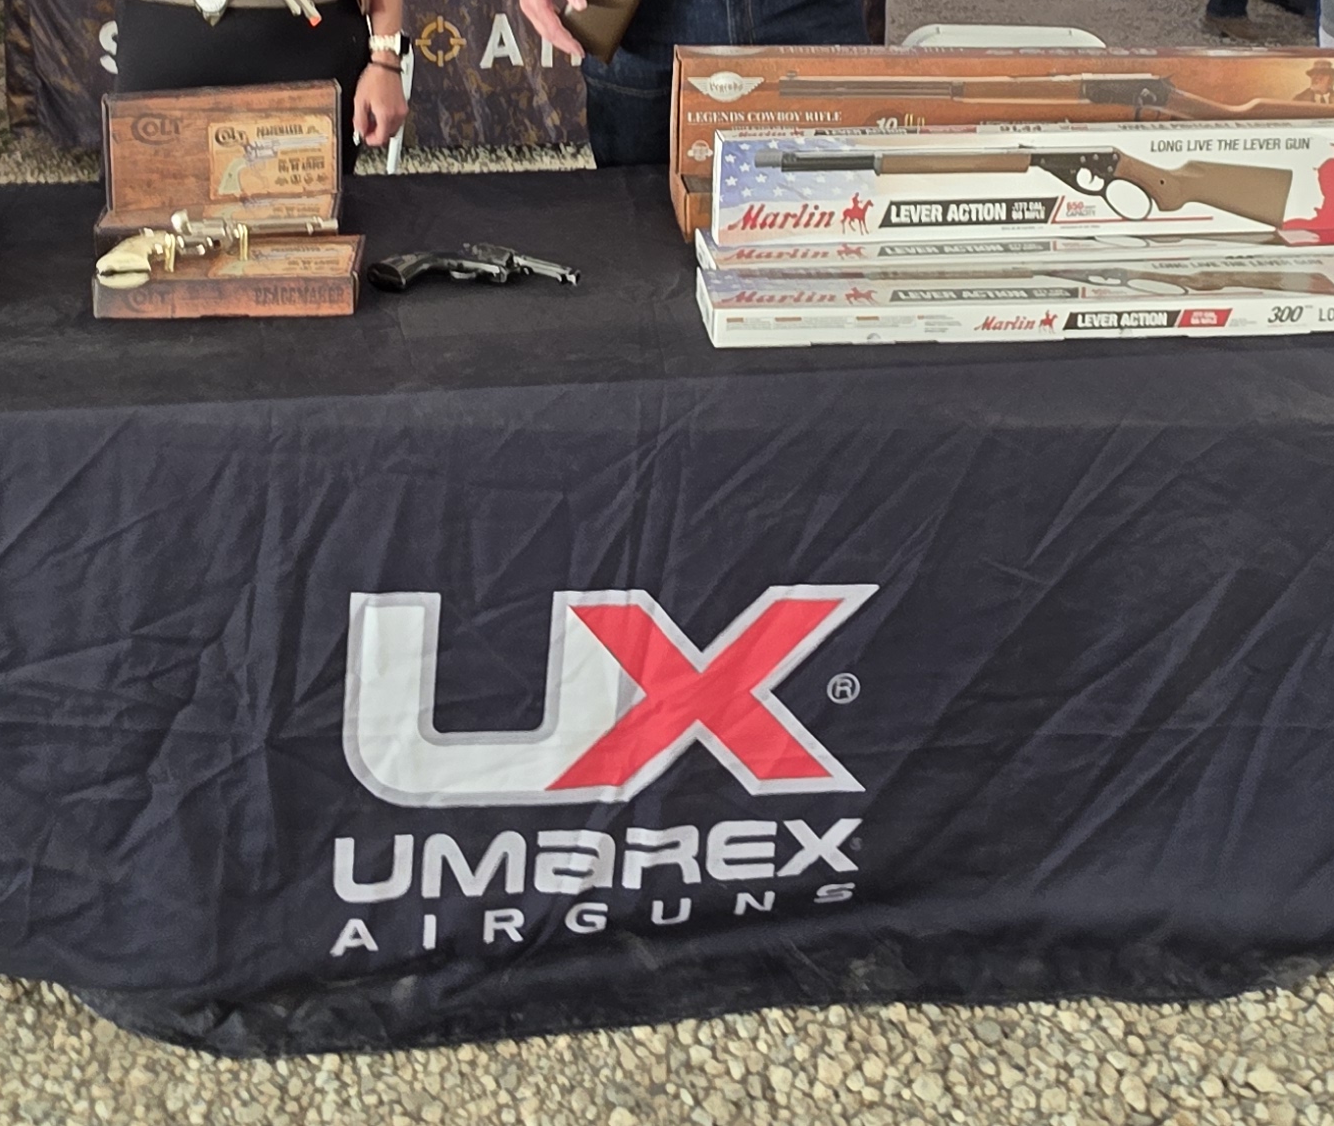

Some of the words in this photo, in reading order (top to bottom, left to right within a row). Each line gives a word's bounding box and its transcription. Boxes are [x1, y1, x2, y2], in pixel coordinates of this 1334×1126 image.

[686, 110, 745, 124] LEGENDS
[747, 110, 803, 123] COWBOY
[805, 109, 843, 123] RIFLE
[131, 112, 184, 146] COLT
[1150, 140, 1183, 152] LONG
[1187, 139, 1213, 151] LIVE
[1217, 138, 1240, 151] THE
[1243, 138, 1281, 150] LEVER
[1285, 137, 1311, 150] GUN
[727, 203, 836, 231] Marlin
[890, 203, 943, 224] LEVER
[946, 202, 1007, 222] ACTION
[724, 248, 830, 262] Marlin
[253, 284, 346, 307] PEACEMAKER
[721, 290, 837, 305] Marlin
[973, 315, 1036, 332] Marlin
[1077, 312, 1119, 328] LEVER
[1120, 311, 1168, 327] ACTION
[1267, 305, 1304, 324] 300
[342, 584, 880, 808] UX
[329, 881, 856, 957] AIRGUNS
